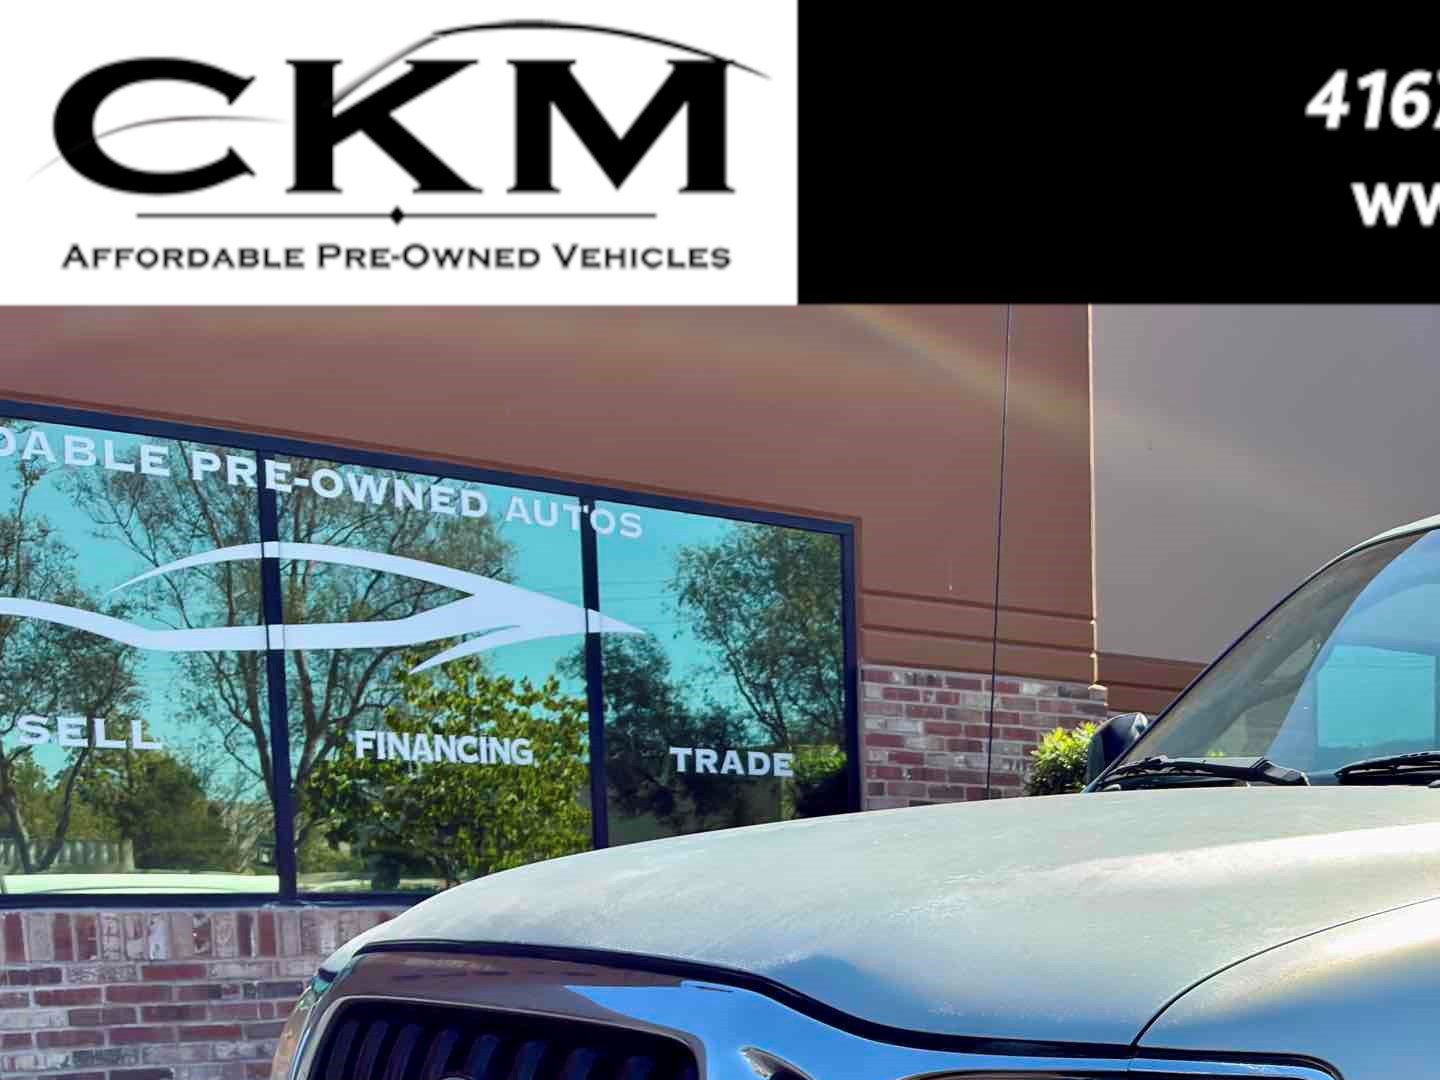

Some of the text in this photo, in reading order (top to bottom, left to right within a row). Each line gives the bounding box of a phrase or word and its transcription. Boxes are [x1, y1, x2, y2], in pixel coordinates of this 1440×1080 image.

[191, 450, 488, 518] PRE-OWNED
[505, 495, 643, 539] AUTOS
[17, 714, 163, 750] SELL
[354, 729, 535, 766] FINANCING
[669, 746, 795, 777] TRADE
